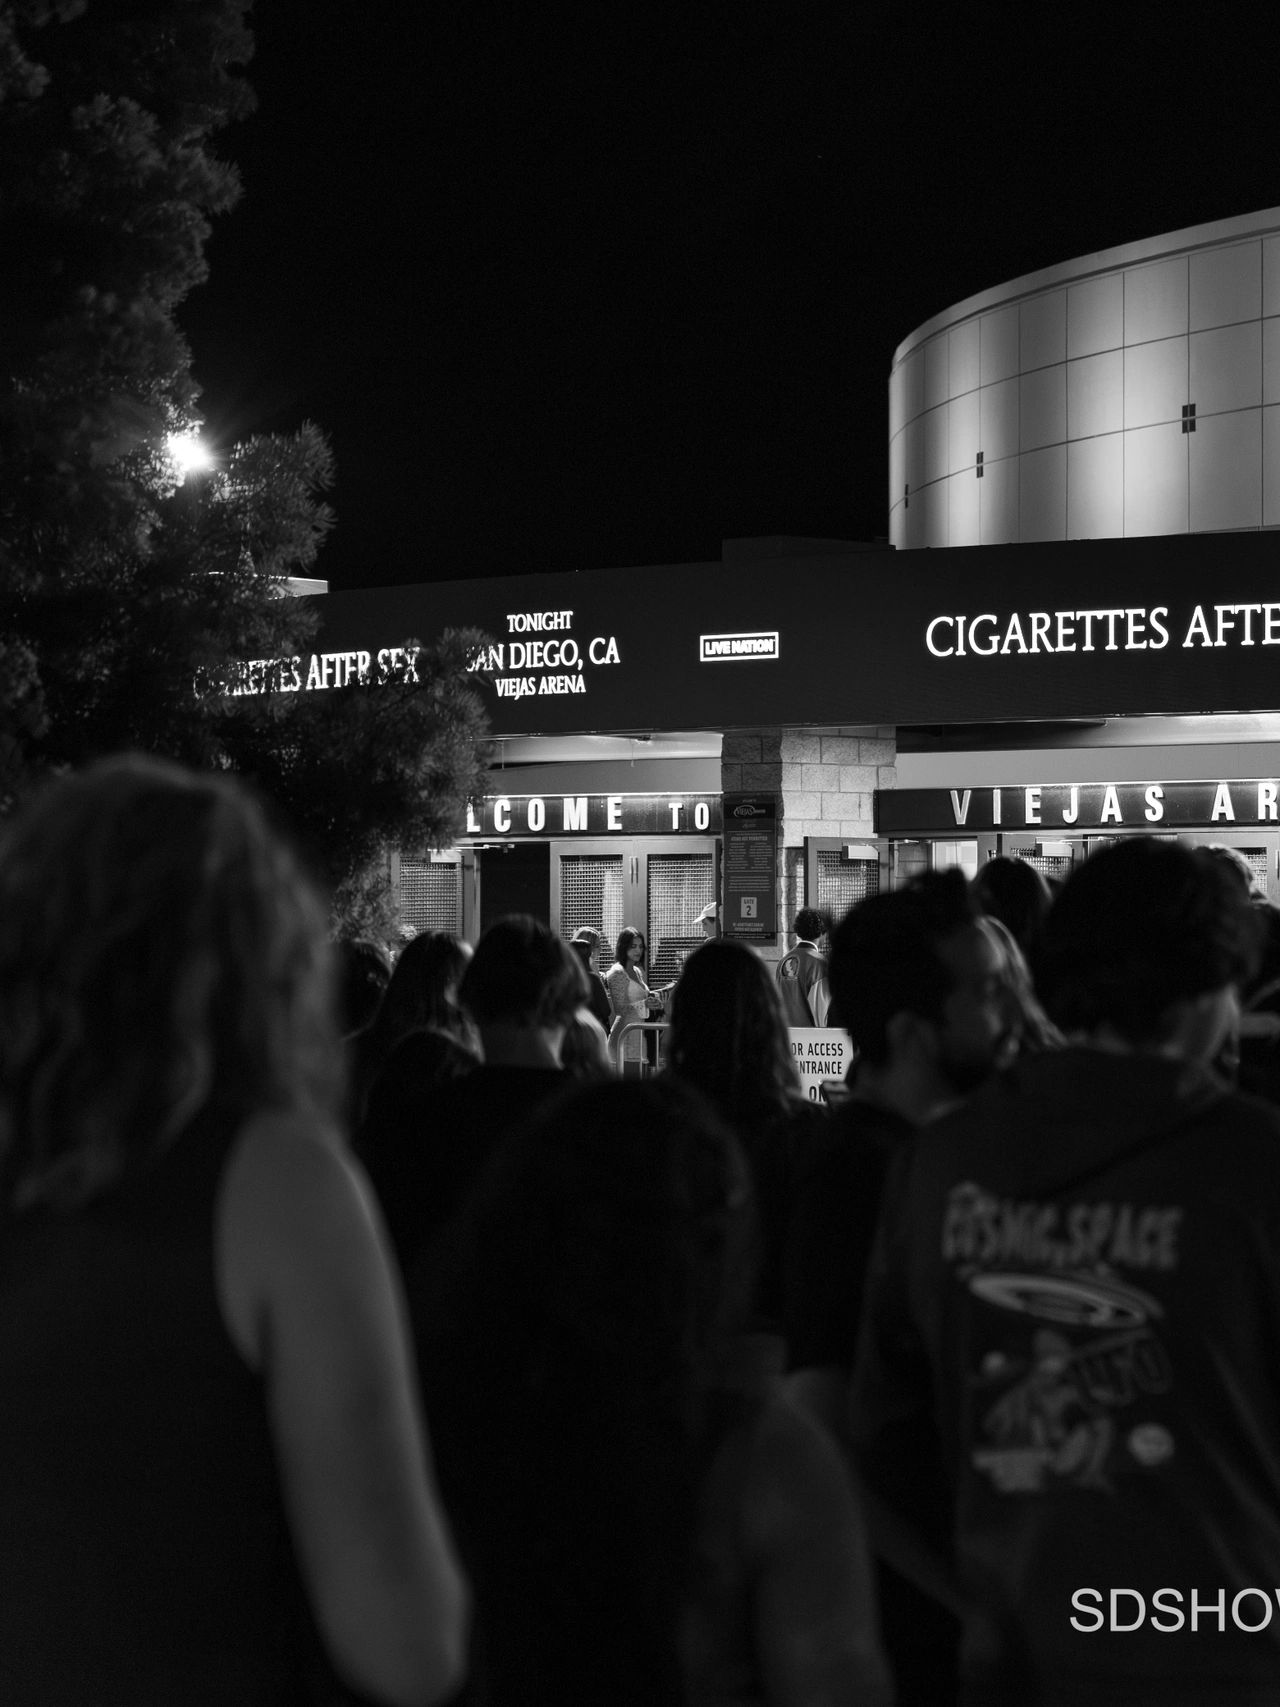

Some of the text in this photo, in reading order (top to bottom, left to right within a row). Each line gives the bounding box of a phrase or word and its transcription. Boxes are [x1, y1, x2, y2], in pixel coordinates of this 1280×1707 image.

[506, 610, 574, 633] TONIGHT
[925, 606, 1170, 658] CIGARETTES
[508, 638, 584, 671] DIEGO,
[588, 636, 621, 666] CA
[705, 638, 774, 655] LIVE NATION
[494, 673, 587, 701] VIEJAS ARENA
[466, 796, 710, 833] LCOME TO
[949, 784, 1165, 825] VIEJAS
[746, 905, 752, 916] 2
[807, 1043, 844, 1056] ACCESS
[797, 1061, 843, 1075] NTRANCE
